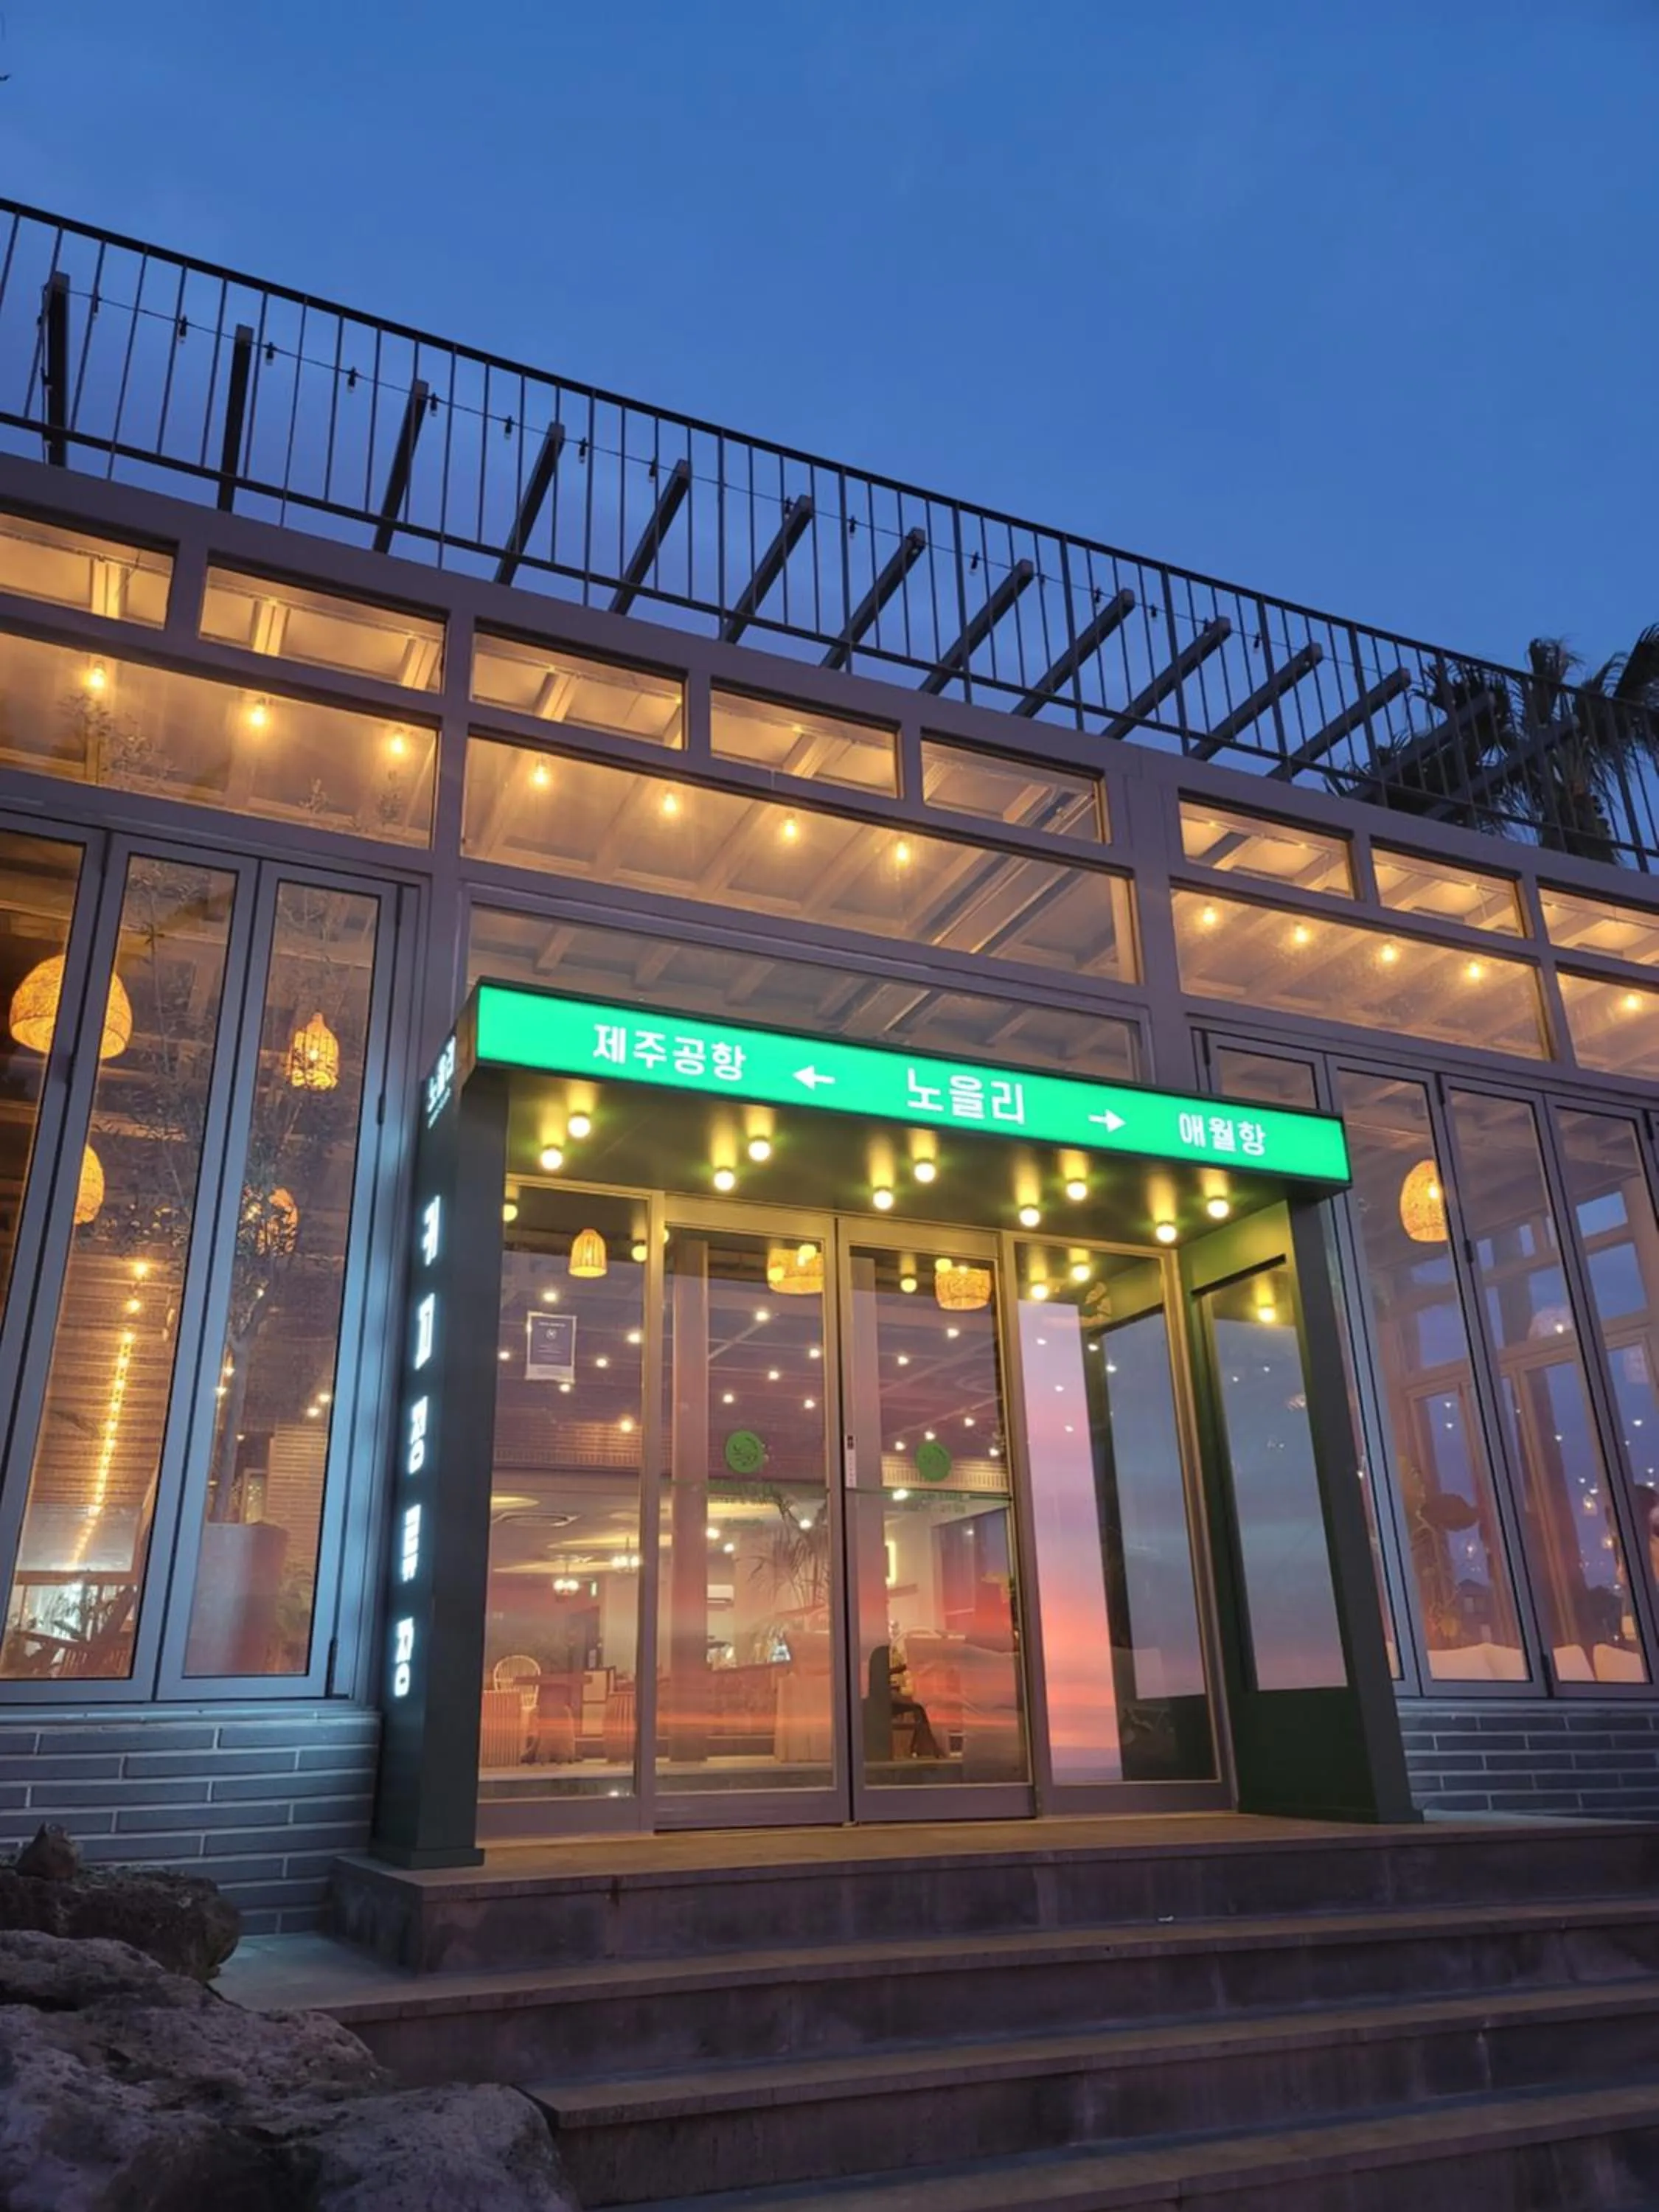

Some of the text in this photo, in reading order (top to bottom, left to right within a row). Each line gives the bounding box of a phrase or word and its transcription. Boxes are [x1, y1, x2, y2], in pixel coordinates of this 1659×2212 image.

[593, 1024, 1266, 1156] 제주공항 노을리 애월항
